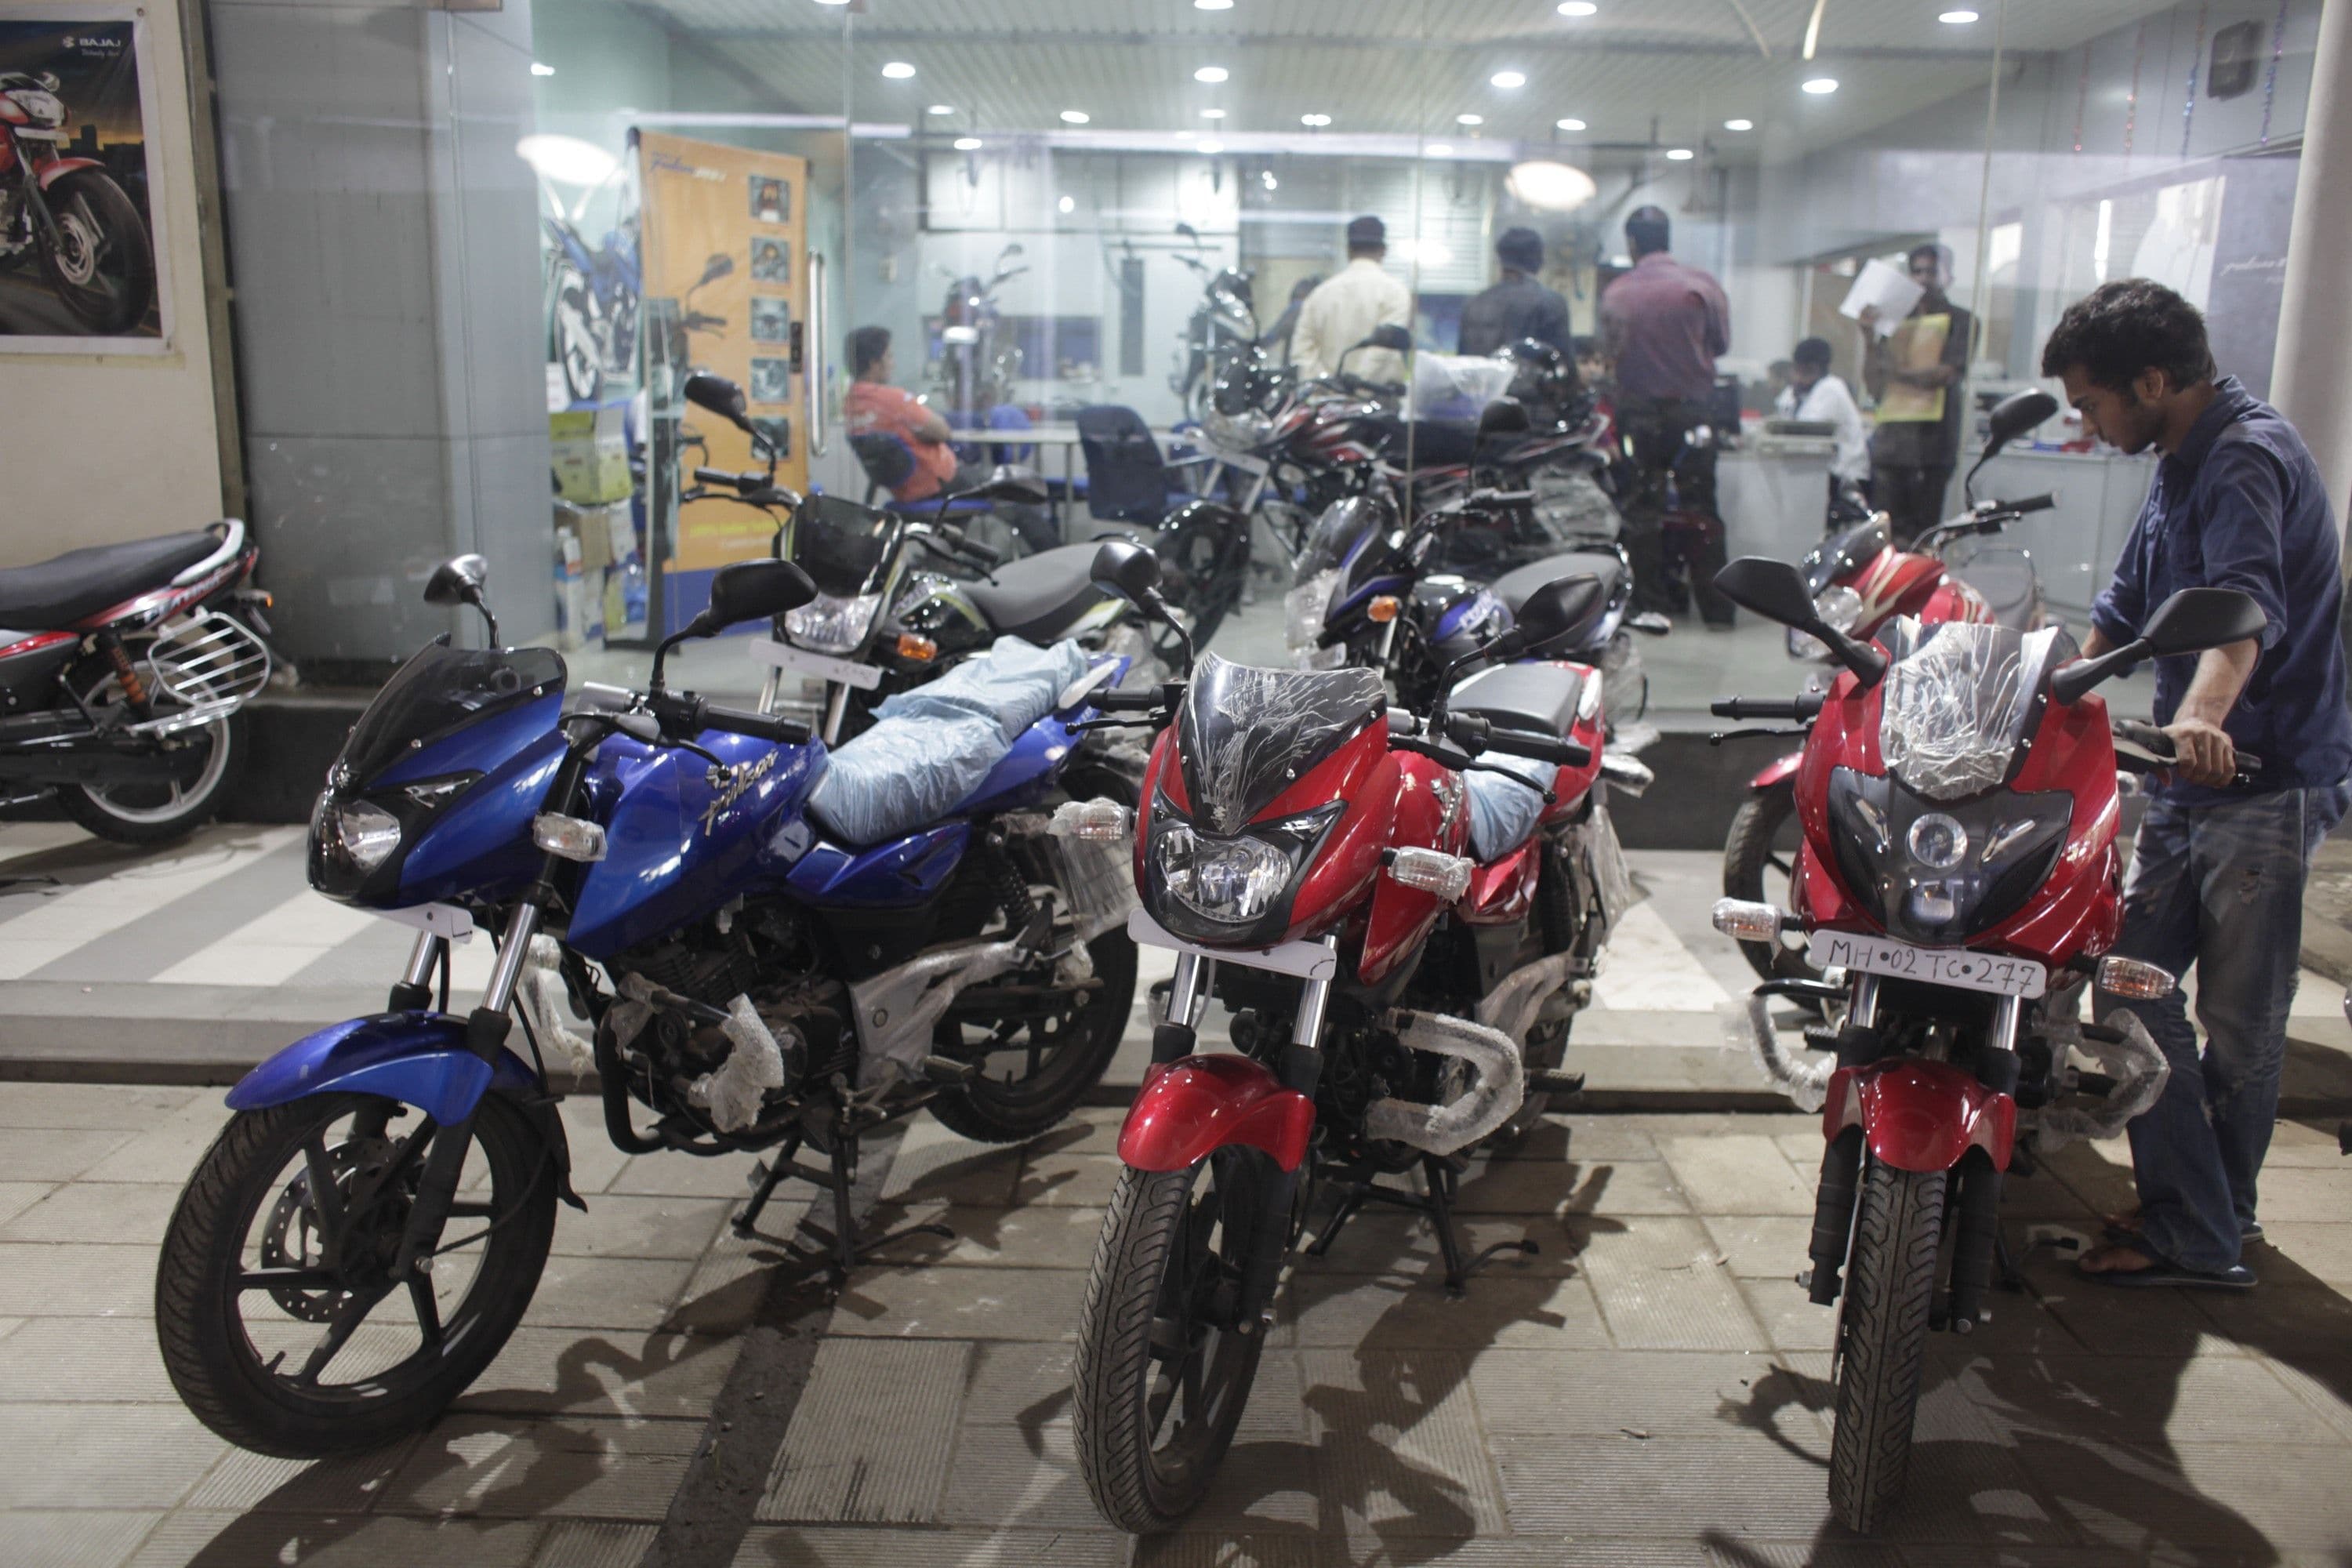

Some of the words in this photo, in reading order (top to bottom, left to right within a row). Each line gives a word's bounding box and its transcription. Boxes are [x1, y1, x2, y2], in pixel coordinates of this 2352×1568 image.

[79, 38, 122, 47] BAJAJ
[1828, 939, 1873, 968] MH
[1975, 957, 2037, 993] 277
